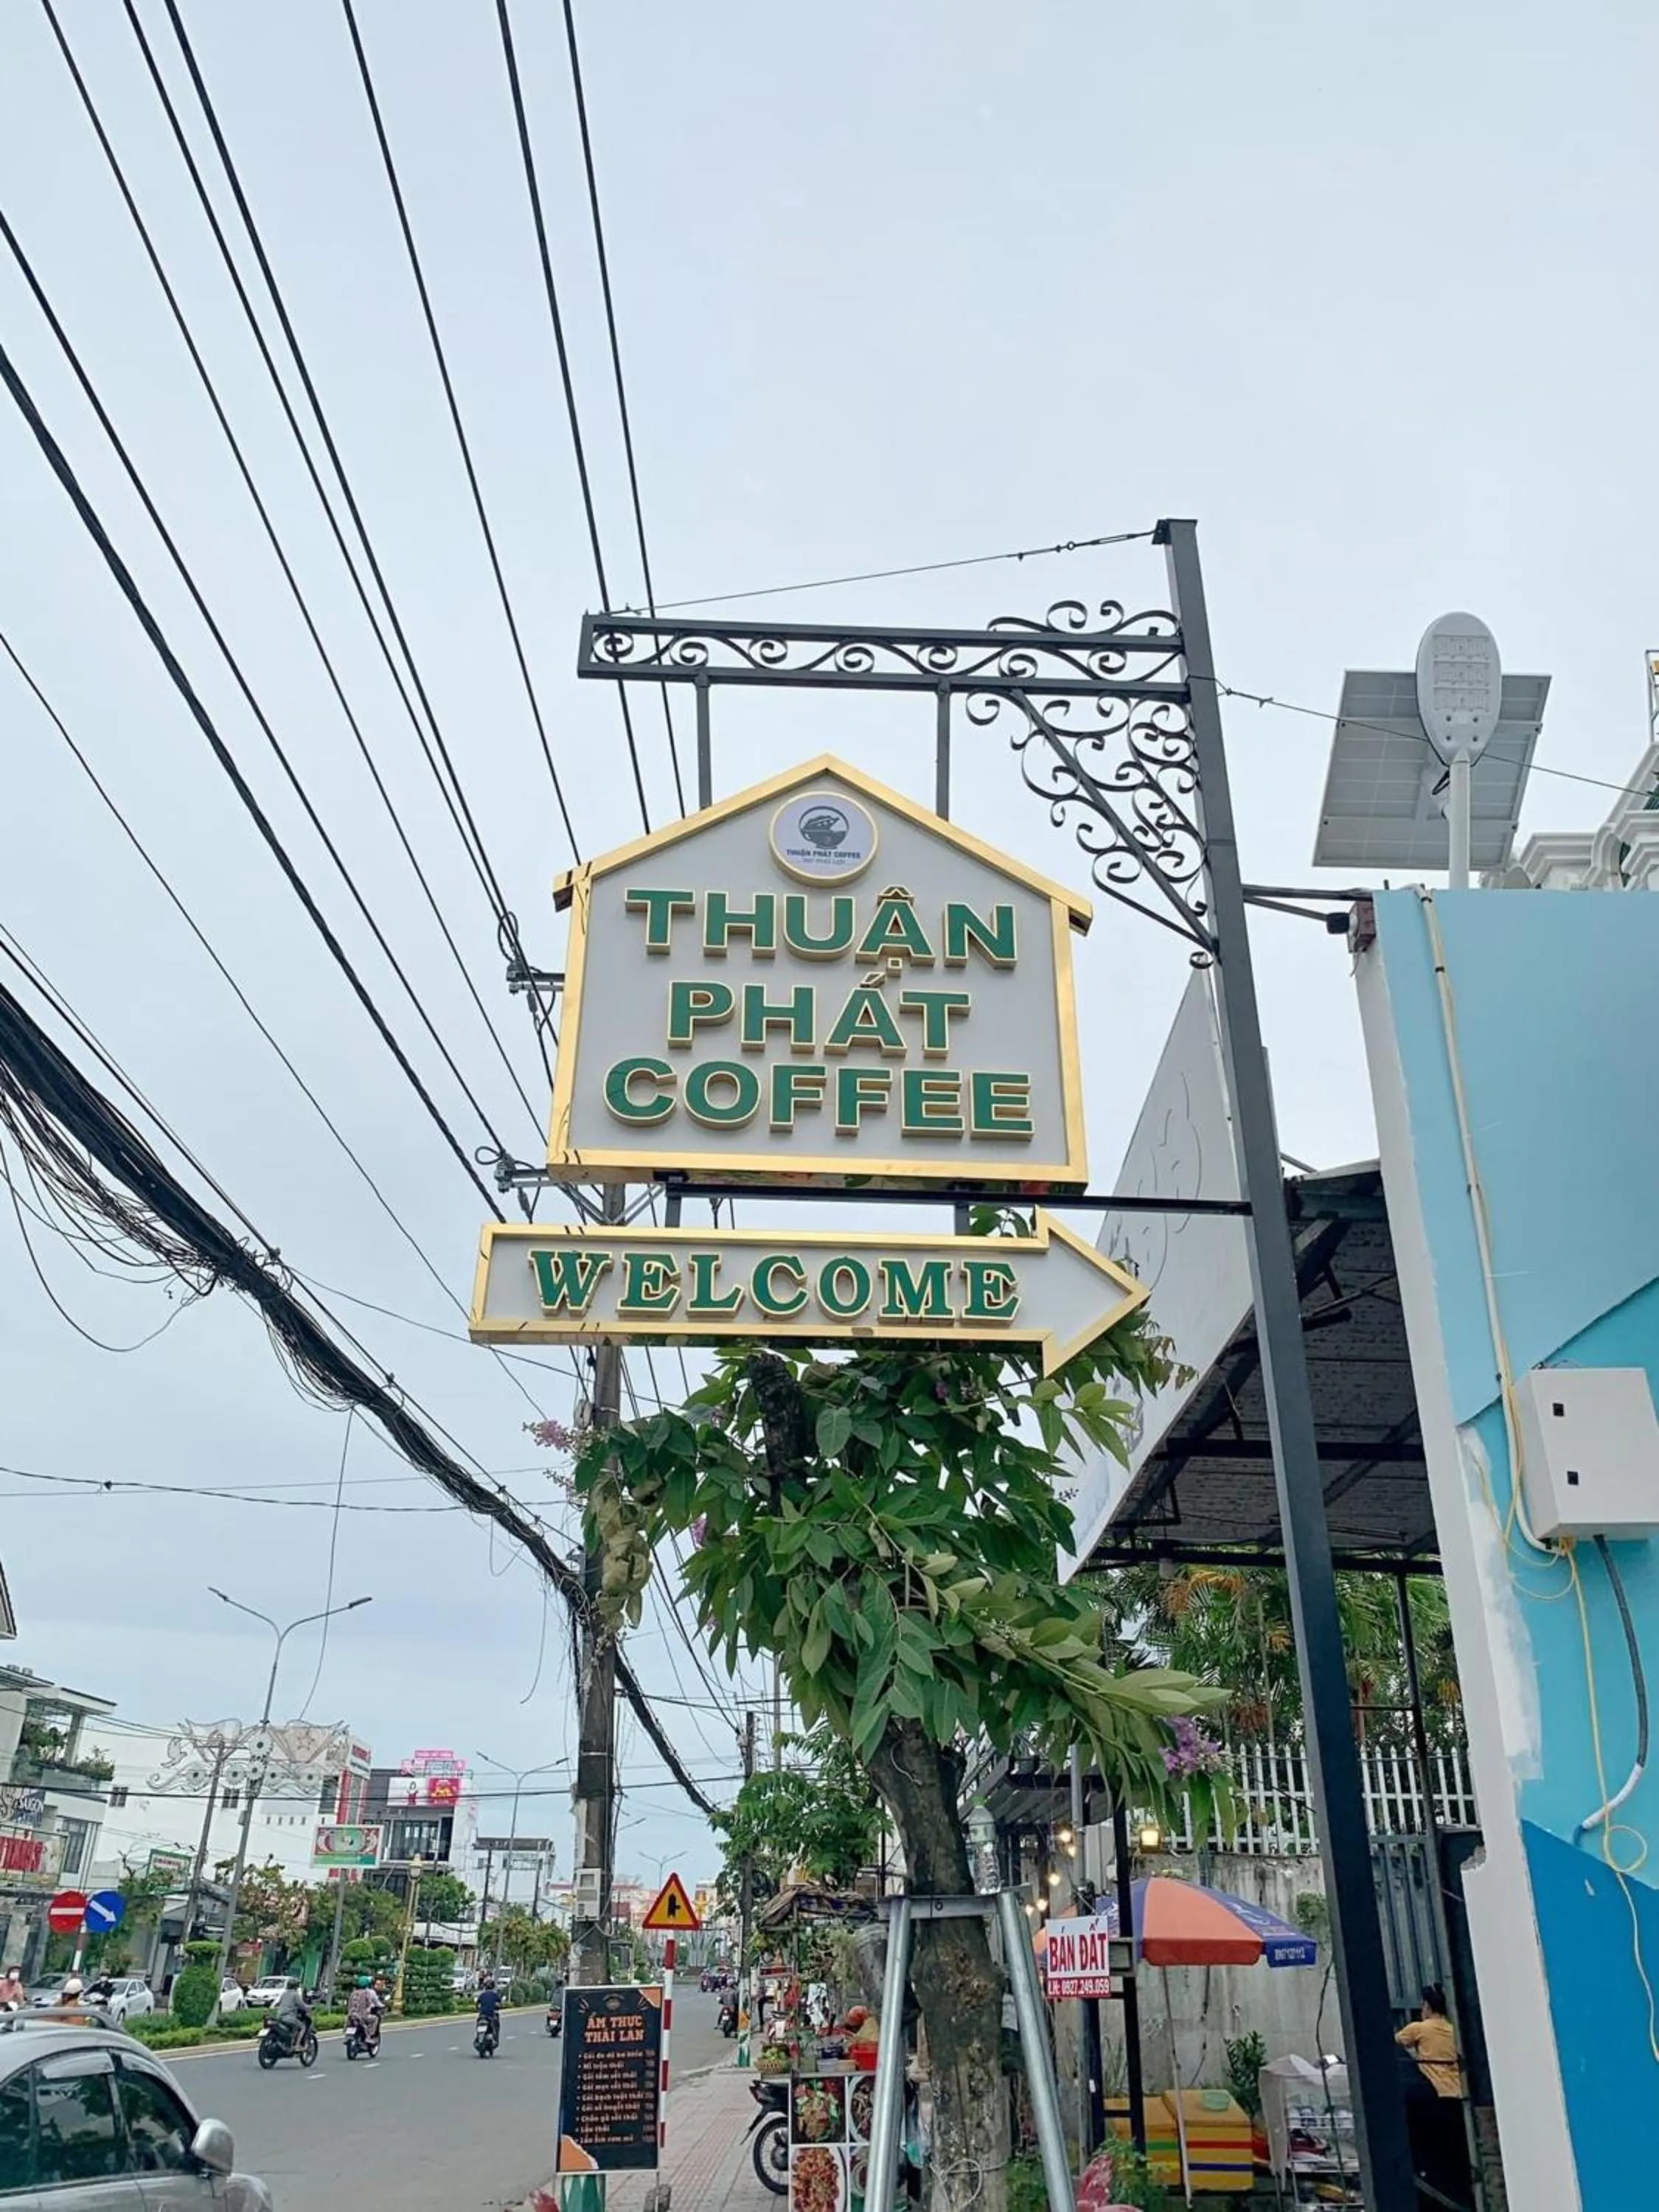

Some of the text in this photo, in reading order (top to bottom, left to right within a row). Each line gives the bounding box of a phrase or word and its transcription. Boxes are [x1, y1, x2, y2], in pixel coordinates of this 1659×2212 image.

[625, 885, 1018, 978] THUẬN
[667, 971, 971, 1059] PHÁT
[603, 1056, 1034, 1141] COFFEE
[528, 1249, 1020, 1326] WELCOME
[1049, 1918, 1107, 1972] BÁN ĐẤT
[619, 2029, 644, 2042] LAN
